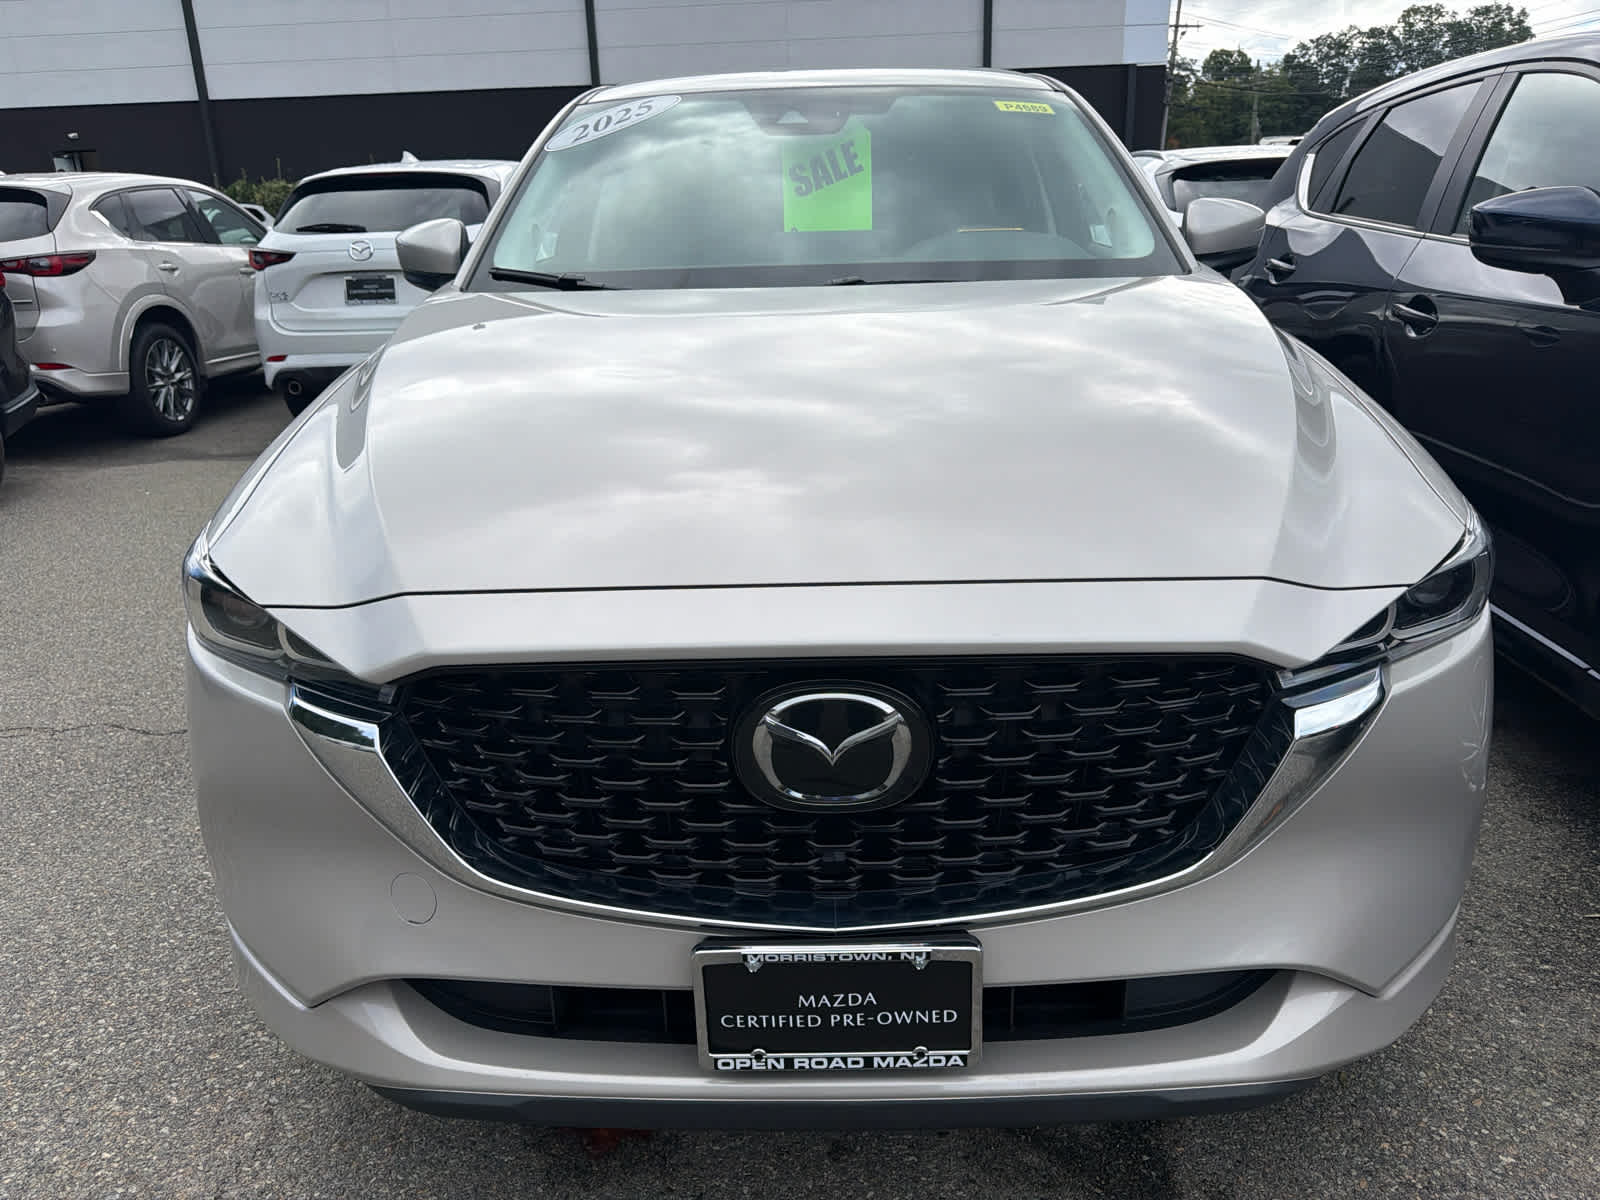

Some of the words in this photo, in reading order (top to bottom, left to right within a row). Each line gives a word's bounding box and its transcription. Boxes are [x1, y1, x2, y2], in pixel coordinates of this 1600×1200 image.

[571, 101, 653, 143] 2025
[788, 139, 865, 197] SALE
[798, 992, 877, 1008] MAZDA
[720, 1014, 822, 1028] CERTIFIED
[830, 1009, 958, 1026] PRE-OWNED
[717, 1058, 785, 1070] OPEN
[793, 1057, 864, 1069] ROAD
[873, 1055, 965, 1068] MAZDA
